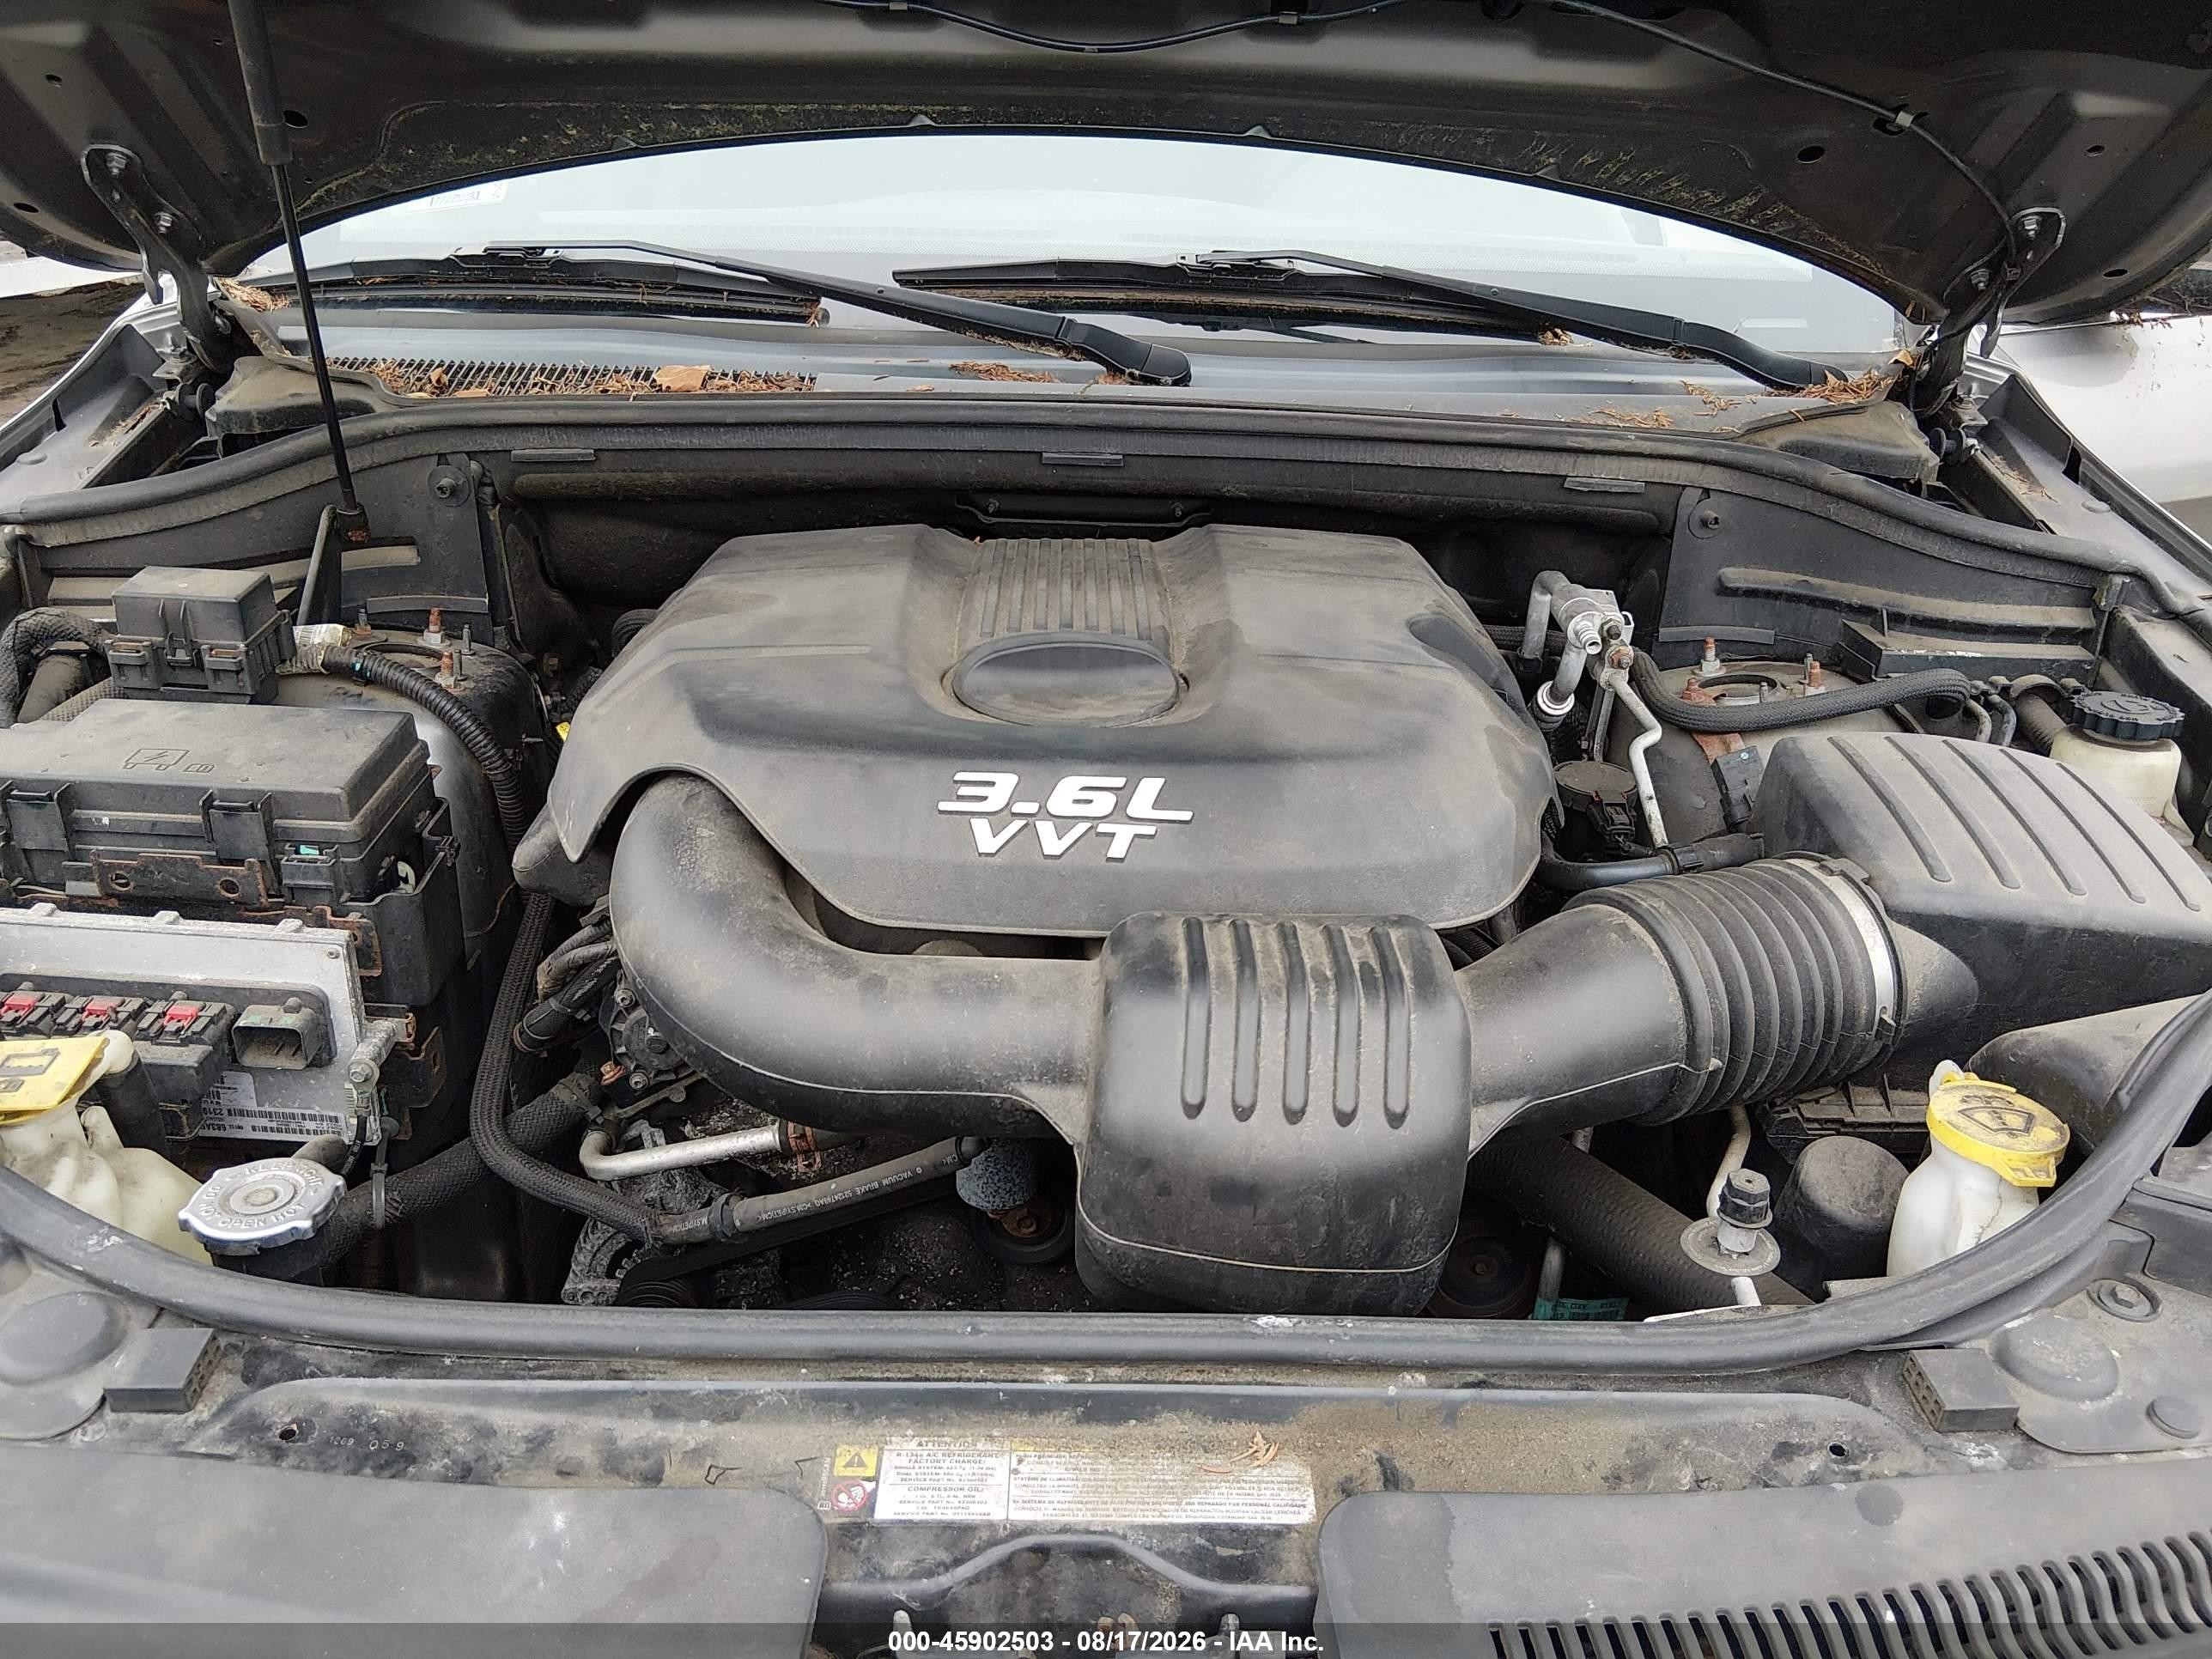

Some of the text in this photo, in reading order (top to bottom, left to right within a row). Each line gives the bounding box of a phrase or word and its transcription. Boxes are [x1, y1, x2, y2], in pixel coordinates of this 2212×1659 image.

[938, 771, 1194, 823] 3.6L
[969, 817, 1158, 861] VVT
[855, 1181, 879, 1196] BRAKE
[881, 1169, 913, 1187] VACUUM
[218, 1218, 266, 1228] OPEN
[270, 1203, 304, 1222] HOT
